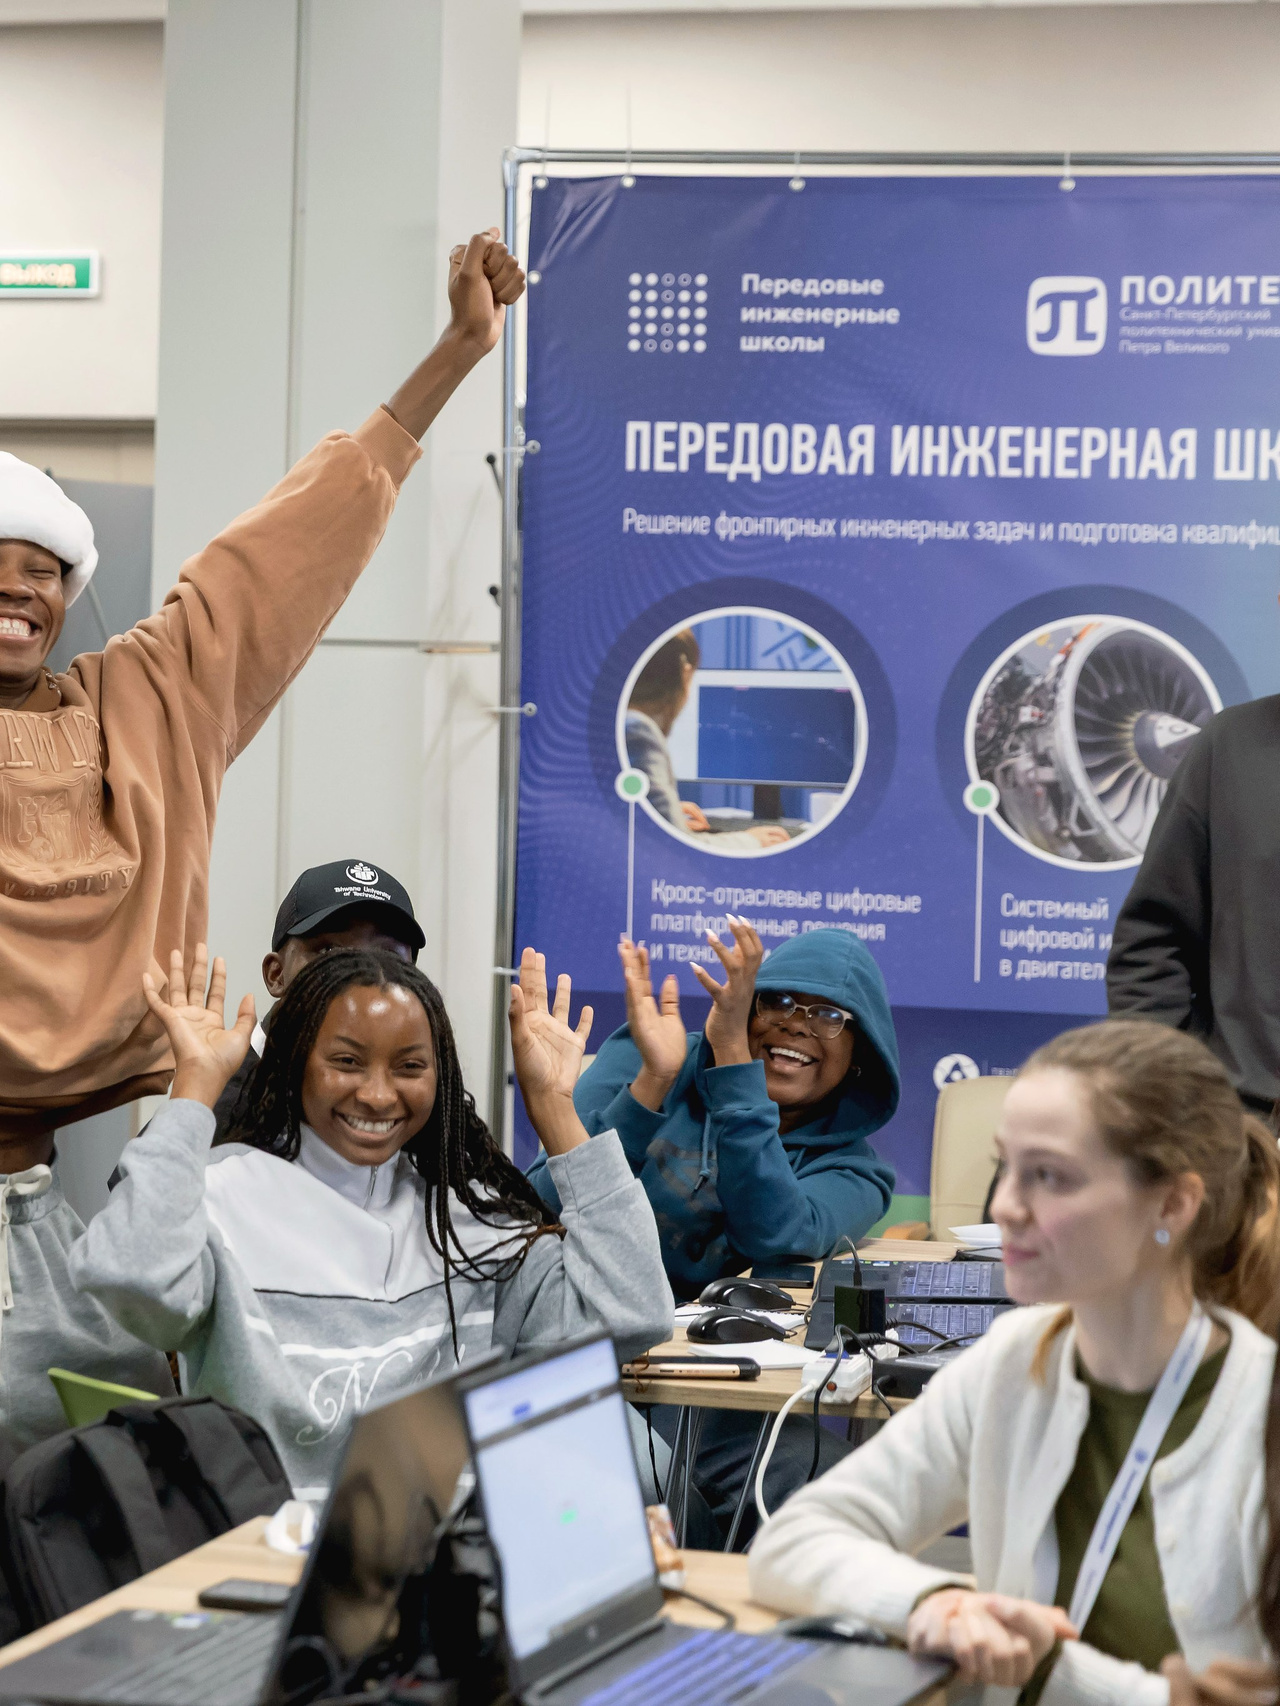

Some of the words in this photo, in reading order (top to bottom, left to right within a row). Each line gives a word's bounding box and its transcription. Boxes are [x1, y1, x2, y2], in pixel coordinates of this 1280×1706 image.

[741, 273, 885, 299] Передовые
[1120, 275, 1280, 305] ПОЛИТЕ
[740, 306, 901, 329] инженерные
[740, 336, 826, 352] школы
[625, 420, 876, 483] ПЕРЕДОВАЯ
[890, 424, 1198, 480] ИНЖЕНЕРНАЯ
[622, 507, 711, 535] Решение
[715, 510, 836, 542] фронтирных
[840, 517, 970, 545] инженерных
[973, 521, 1035, 545] задач
[1039, 522, 1054, 542] и
[1058, 522, 1178, 546] подготовка
[651, 878, 822, 910] Кросс-отраслевые
[825, 887, 922, 916] цифровые
[1000, 892, 1109, 920] Системный
[650, 943, 663, 960] и
[1000, 924, 1095, 954] цифровой
[999, 958, 1013, 977] в
